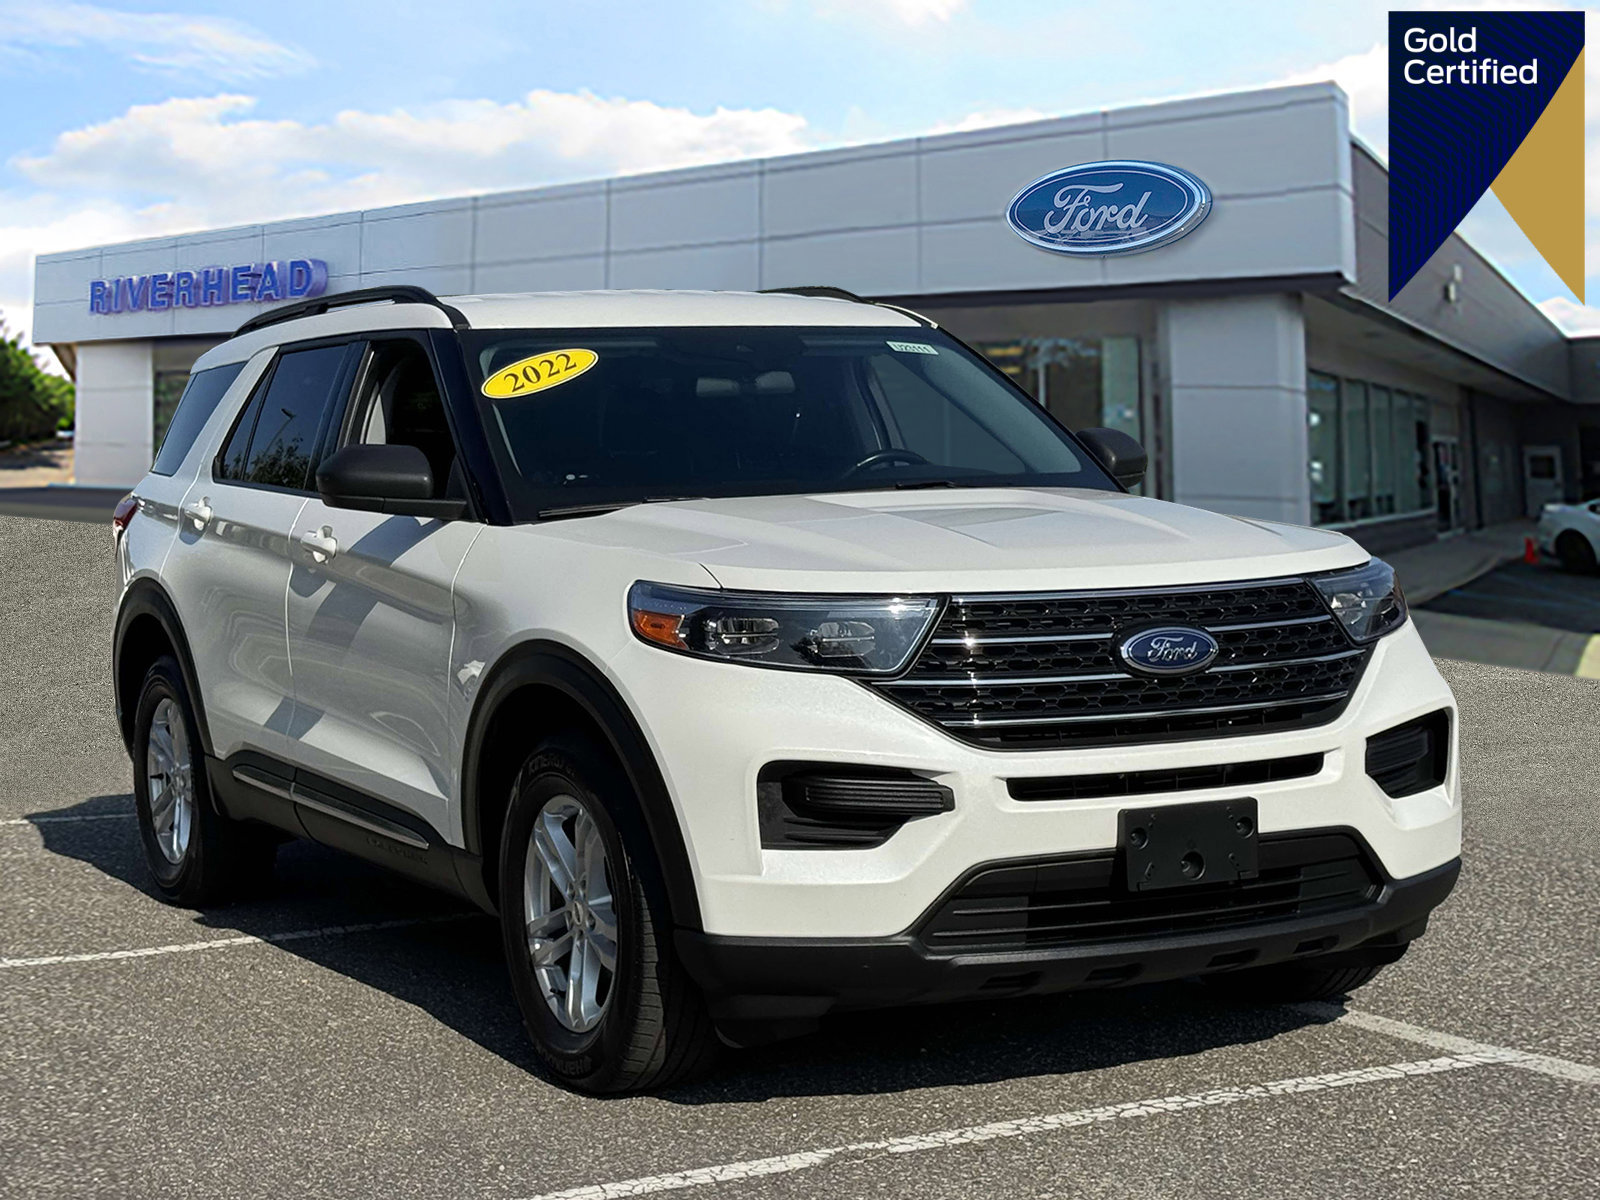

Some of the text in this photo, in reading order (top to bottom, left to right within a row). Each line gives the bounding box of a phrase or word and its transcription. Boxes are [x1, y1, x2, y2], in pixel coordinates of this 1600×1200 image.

[1044, 183, 1152, 234] Ford
[89, 259, 324, 315] RIVERHEAD
[503, 353, 577, 392] 2022
[1147, 636, 1198, 662] Ford
